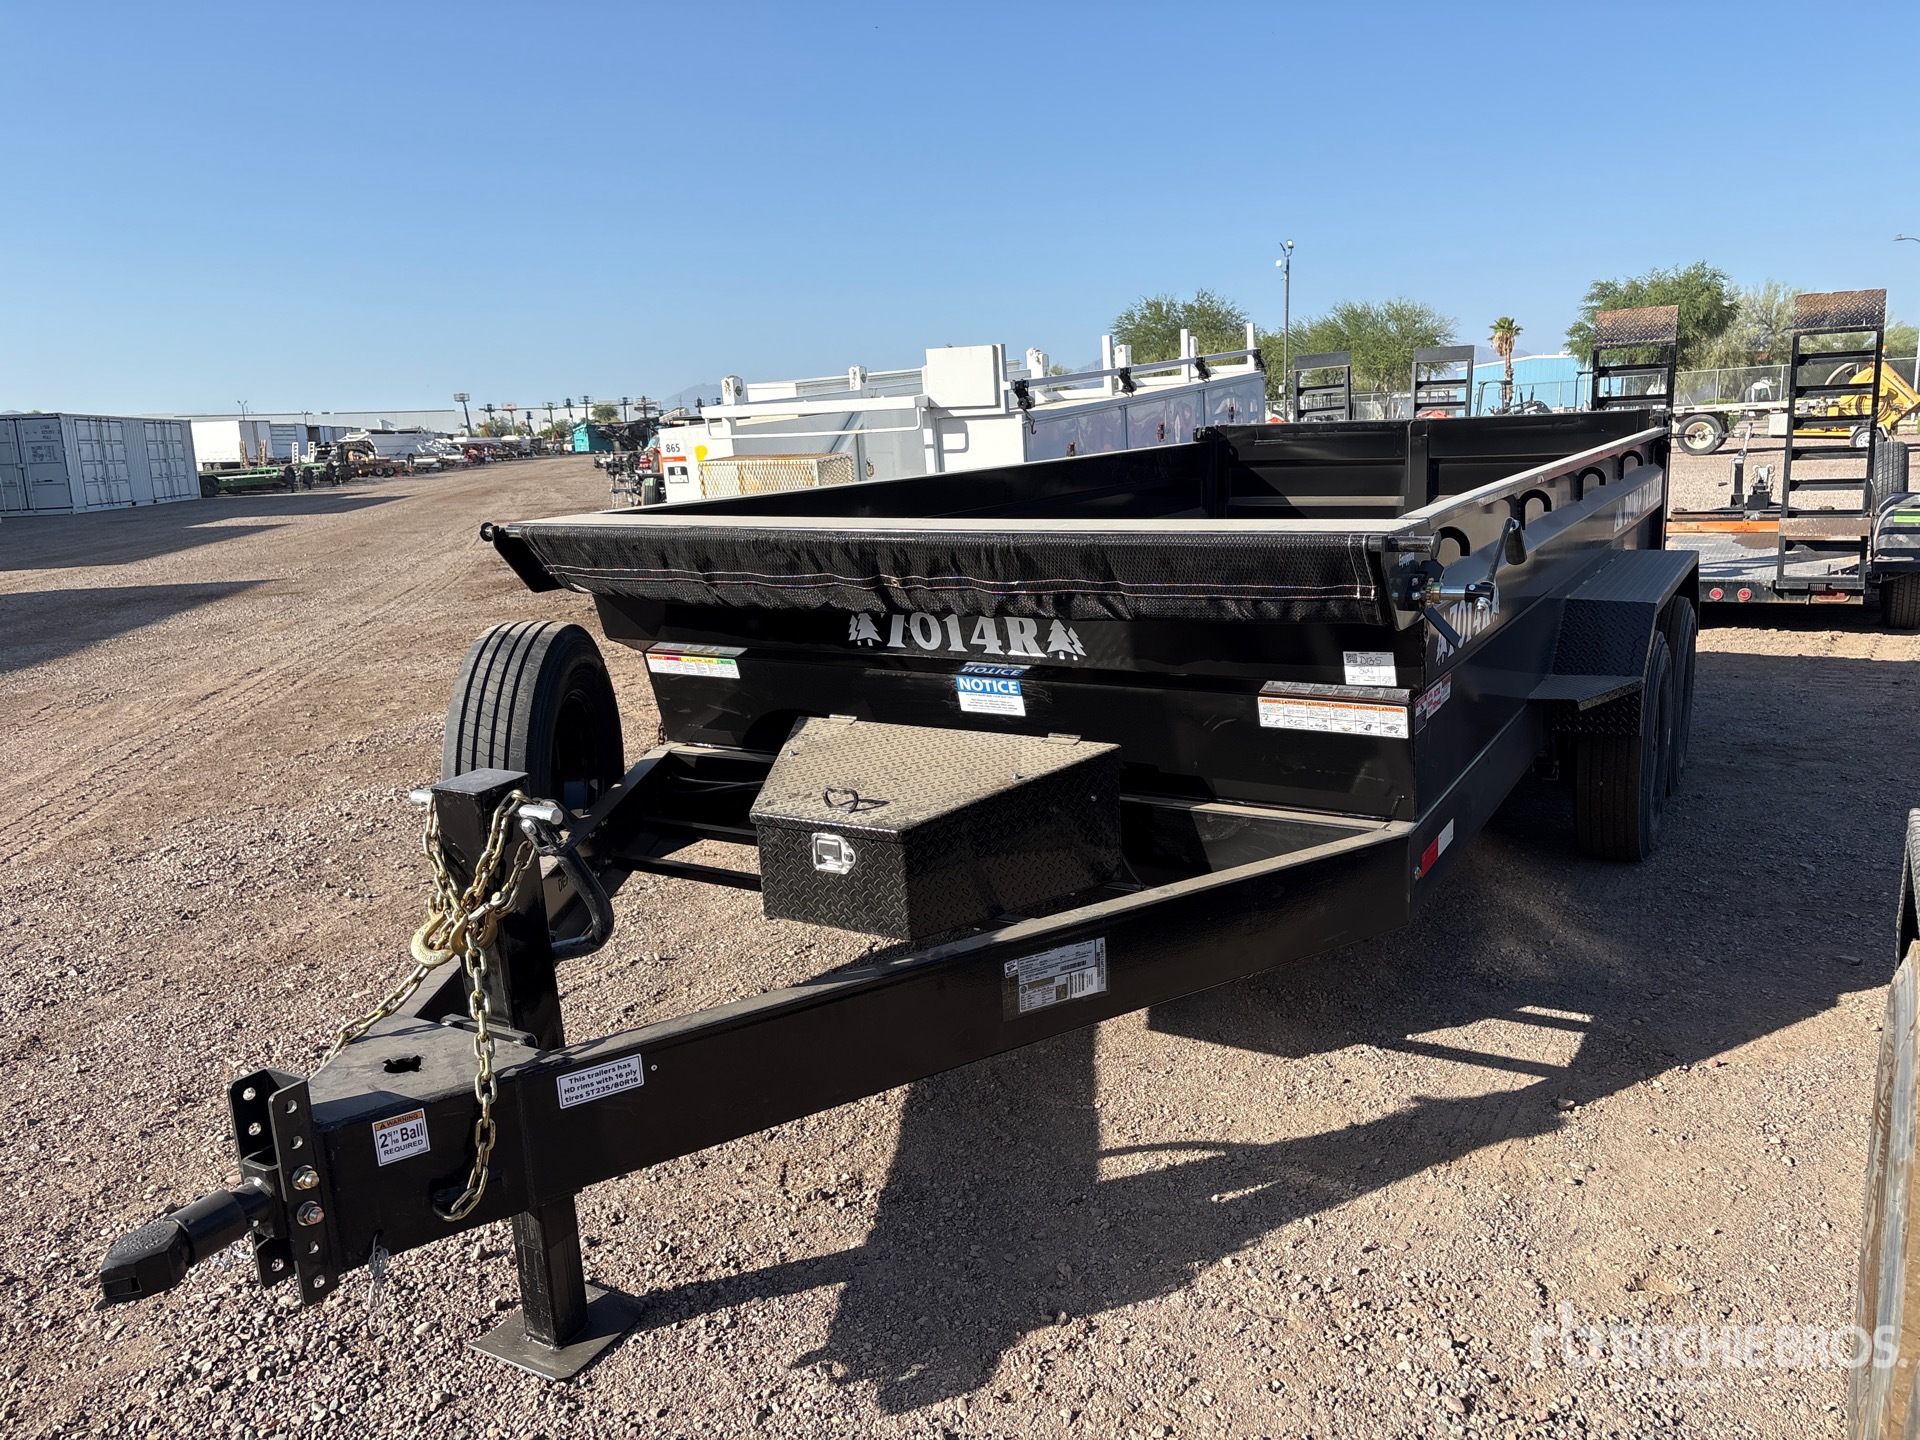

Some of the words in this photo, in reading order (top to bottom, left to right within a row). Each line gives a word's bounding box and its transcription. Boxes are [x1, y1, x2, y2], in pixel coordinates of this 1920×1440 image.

[665, 443, 681, 453] 865
[959, 678, 1019, 694] NOTICE
[564, 1086, 576, 1095] HD
[577, 1081, 594, 1091] rims
[596, 1076, 614, 1086] with
[615, 1072, 624, 1081] 16
[625, 1069, 638, 1079] ply
[569, 1076, 586, 1085] This
[587, 1066, 616, 1079] trailers
[617, 1063, 632, 1071] has
[565, 1092, 584, 1103] tires
[585, 1076, 639, 1097] ST235/80R16
[387, 1113, 419, 1126] WARNING
[400, 1122, 424, 1142] Ball
[383, 1139, 424, 1156] REQUIRED
